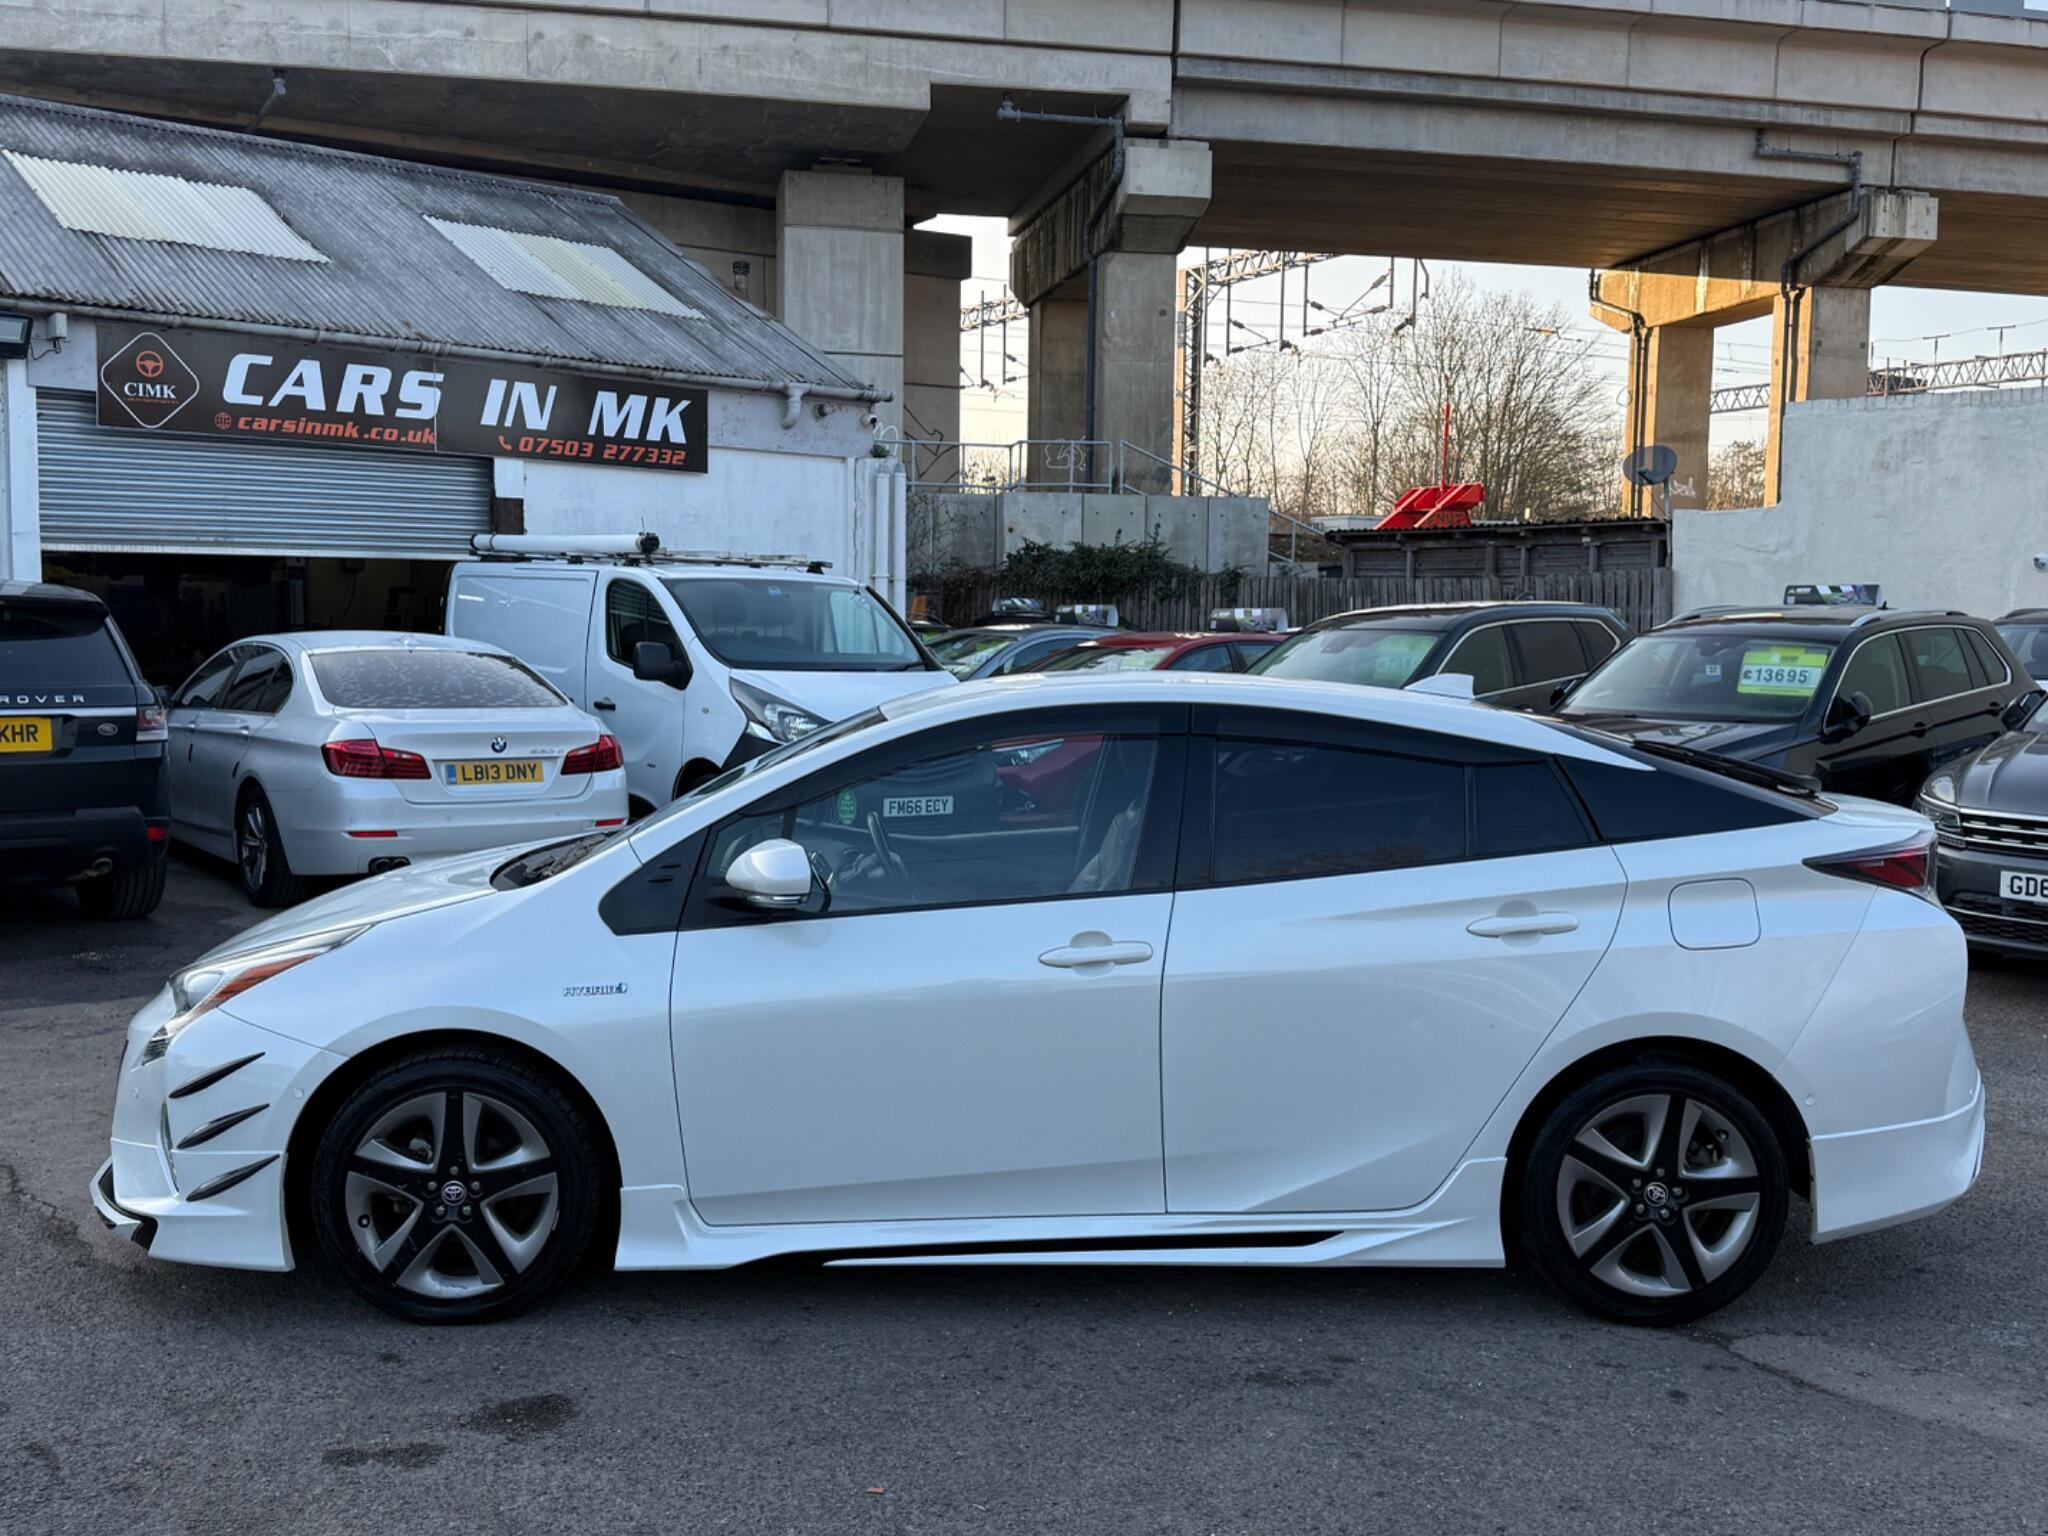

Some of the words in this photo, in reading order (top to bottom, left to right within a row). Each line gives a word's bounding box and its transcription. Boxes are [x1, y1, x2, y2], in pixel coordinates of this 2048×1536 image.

[123, 382, 177, 399] CIMK
[222, 353, 444, 420] CARS
[480, 379, 557, 431] IN
[587, 390, 692, 444] MK
[237, 416, 437, 445] carsinmk.co.uk
[518, 436, 594, 458] 07503
[602, 443, 687, 465] 277332
[0, 694, 85, 704] ROVER
[461, 764, 500, 781] LB13
[505, 763, 537, 780] DNY
[888, 800, 923, 815] FM66
[925, 799, 949, 813] ECY
